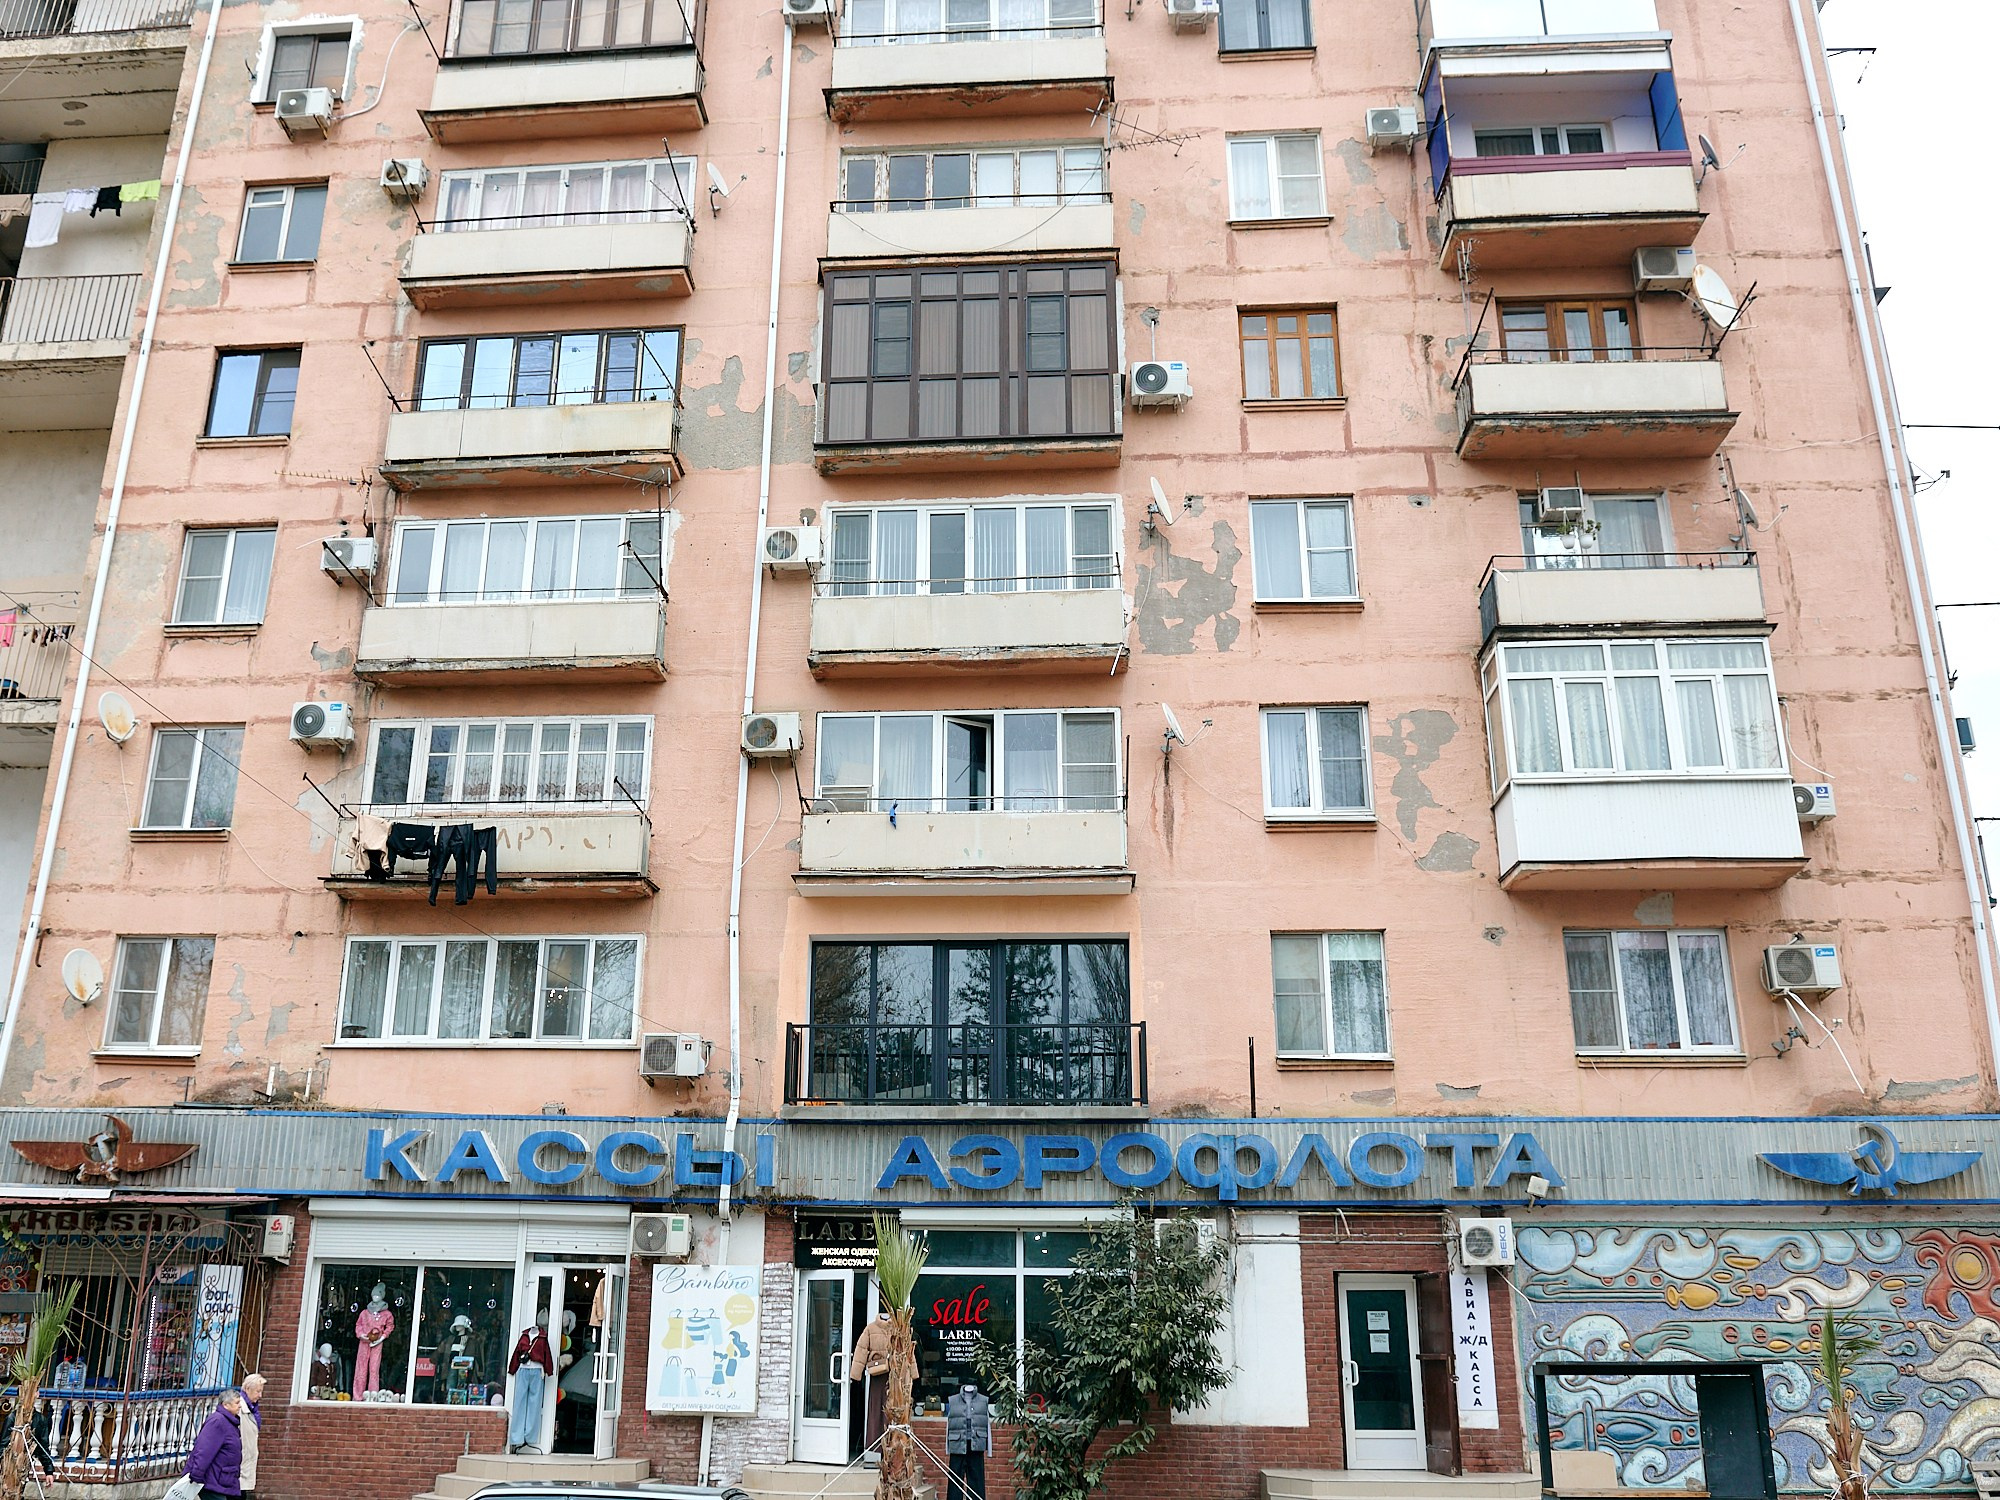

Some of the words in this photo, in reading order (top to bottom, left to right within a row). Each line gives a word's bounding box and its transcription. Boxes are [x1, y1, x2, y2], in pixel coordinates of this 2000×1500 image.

[363, 1128, 777, 1188] КАССЫ
[873, 1131, 1567, 1202] АЭРОФЛОТА
[798, 1221, 876, 1241] LARE
[1498, 1224, 1508, 1259] BEKO
[811, 1247, 850, 1256] ЖЕНСКАЯ
[656, 1266, 754, 1293] Bambino
[929, 1284, 990, 1325] sale
[1464, 1277, 1476, 1320] АВИА
[939, 1329, 982, 1340] LAREN
[1459, 1335, 1488, 1346] Ж/Д
[1469, 1351, 1483, 1407] КАССА
